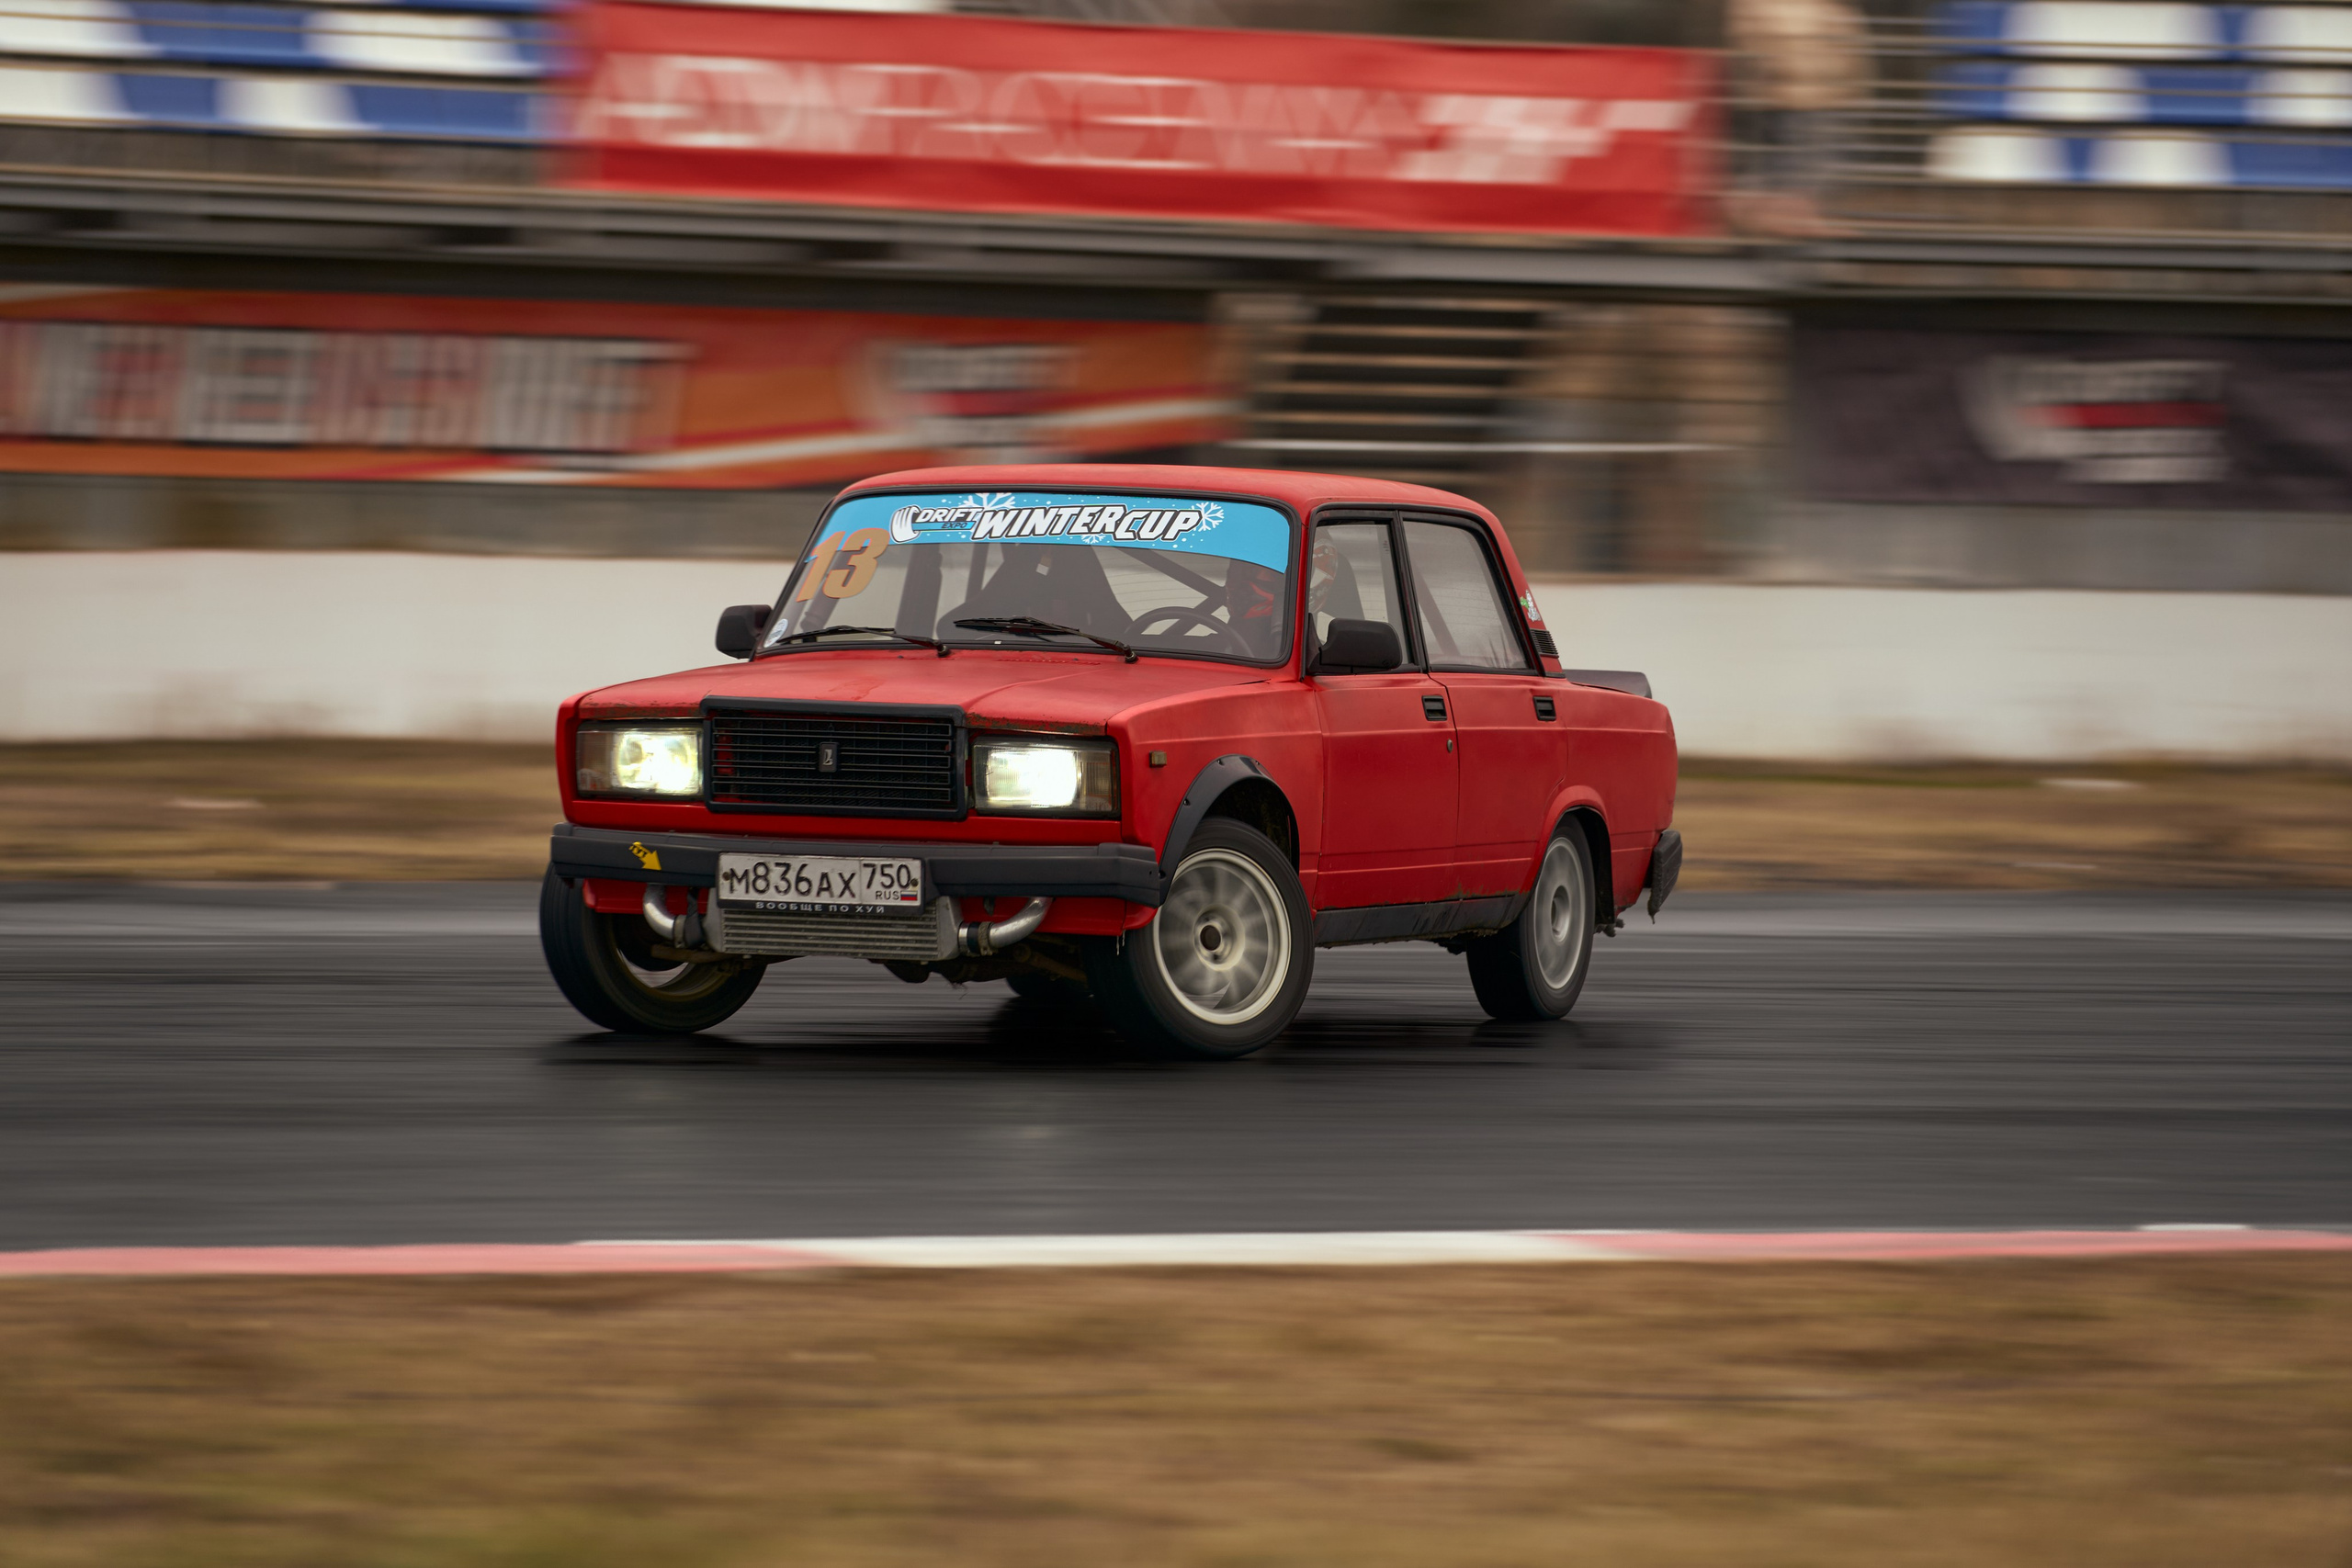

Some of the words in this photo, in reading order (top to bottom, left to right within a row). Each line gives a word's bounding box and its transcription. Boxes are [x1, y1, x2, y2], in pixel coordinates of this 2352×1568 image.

[915, 507, 983, 523] DRIFT
[941, 521, 968, 529] EXPO
[796, 527, 891, 603] 13
[862, 863, 911, 890] 750
[875, 890, 899, 901] RUS
[755, 901, 823, 912] ВООБЩЕ
[829, 904, 850, 913] ПО
[854, 905, 885, 914] ХУЙ
